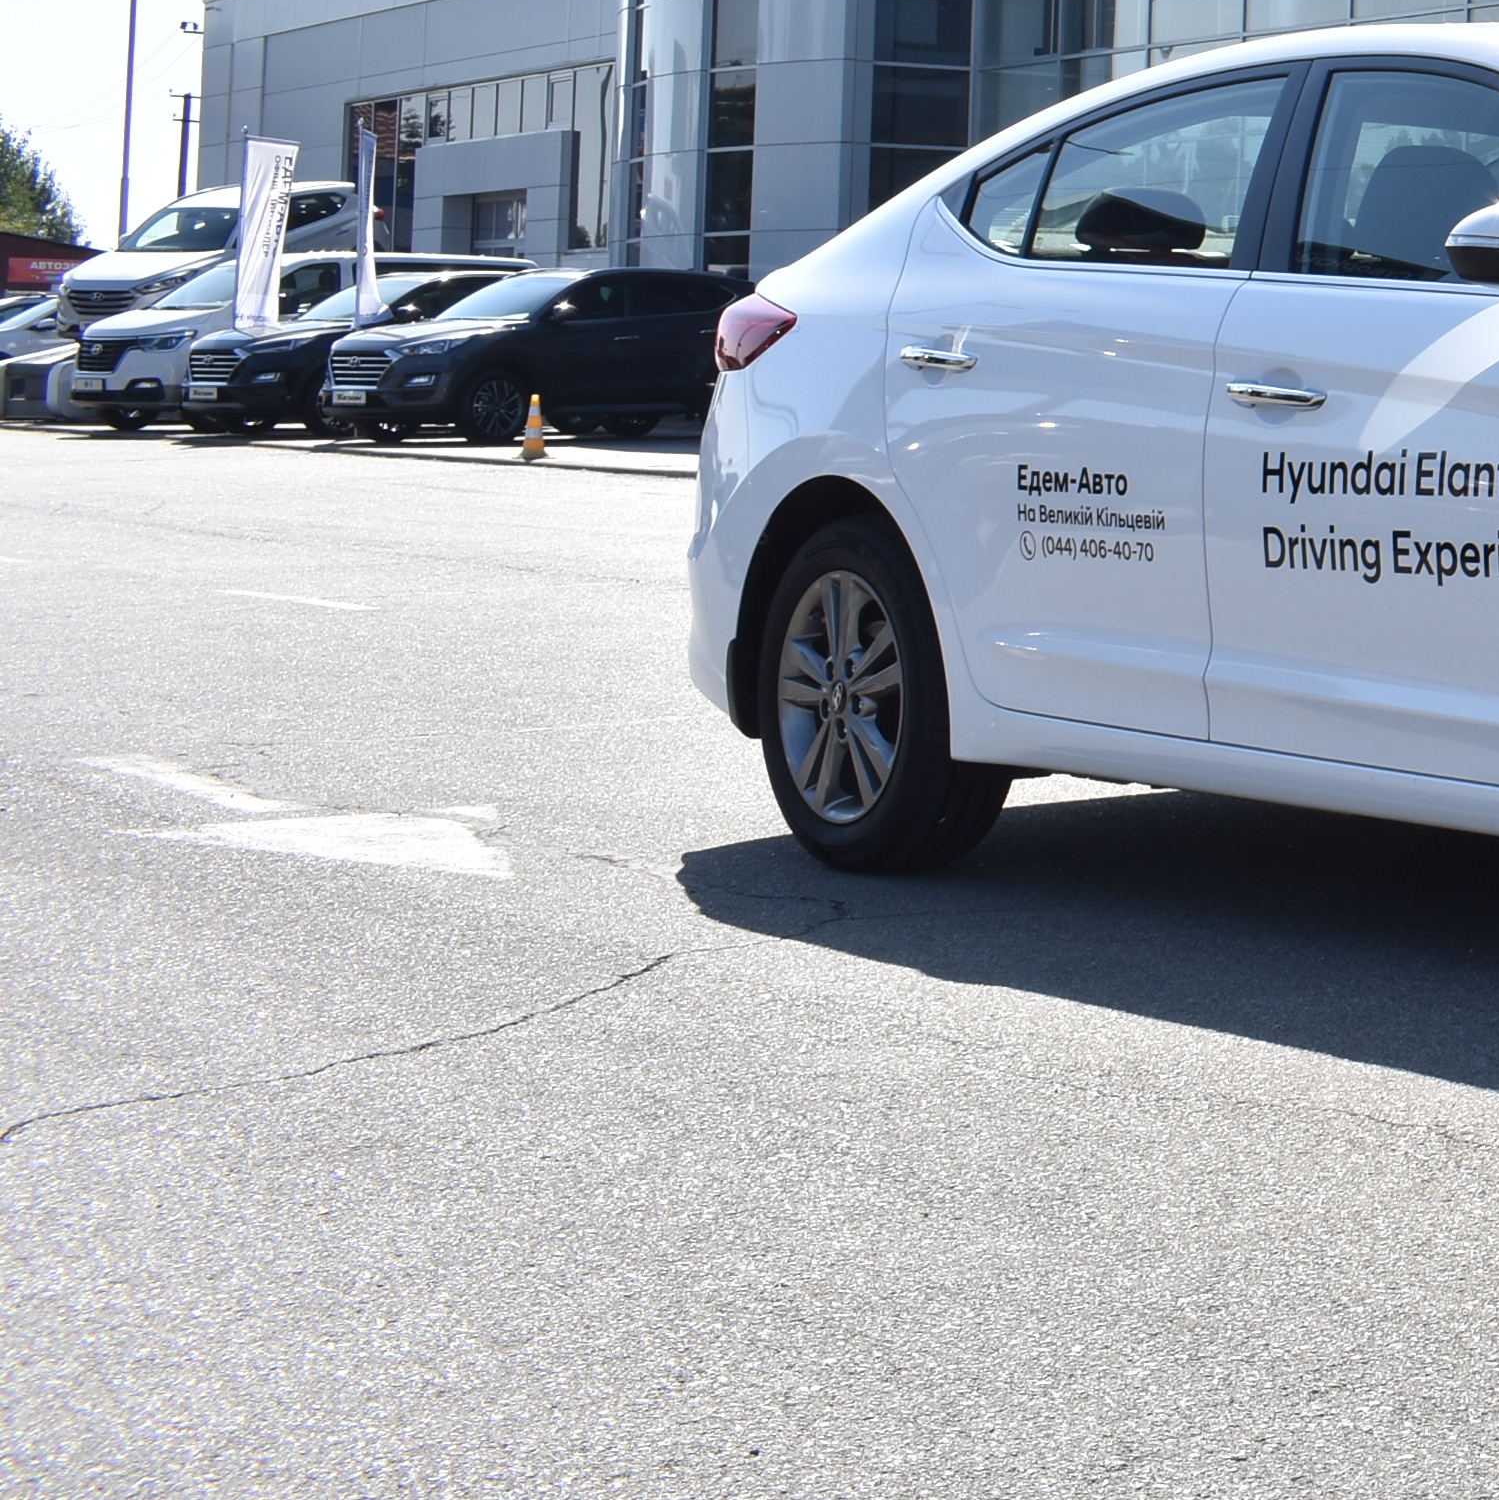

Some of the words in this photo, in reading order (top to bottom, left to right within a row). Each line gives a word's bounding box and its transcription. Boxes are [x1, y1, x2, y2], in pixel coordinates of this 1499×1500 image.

[1017, 463, 1128, 497] Едем-Авто
[1261, 448, 1408, 505] Hyundai
[1017, 503, 1036, 523] На
[1039, 504, 1094, 527] Великій
[1096, 506, 1166, 532] Кільцевій
[1041, 535, 1077, 561] (044)
[1079, 538, 1155, 562] 406-40-70
[1262, 524, 1381, 584] Driving
